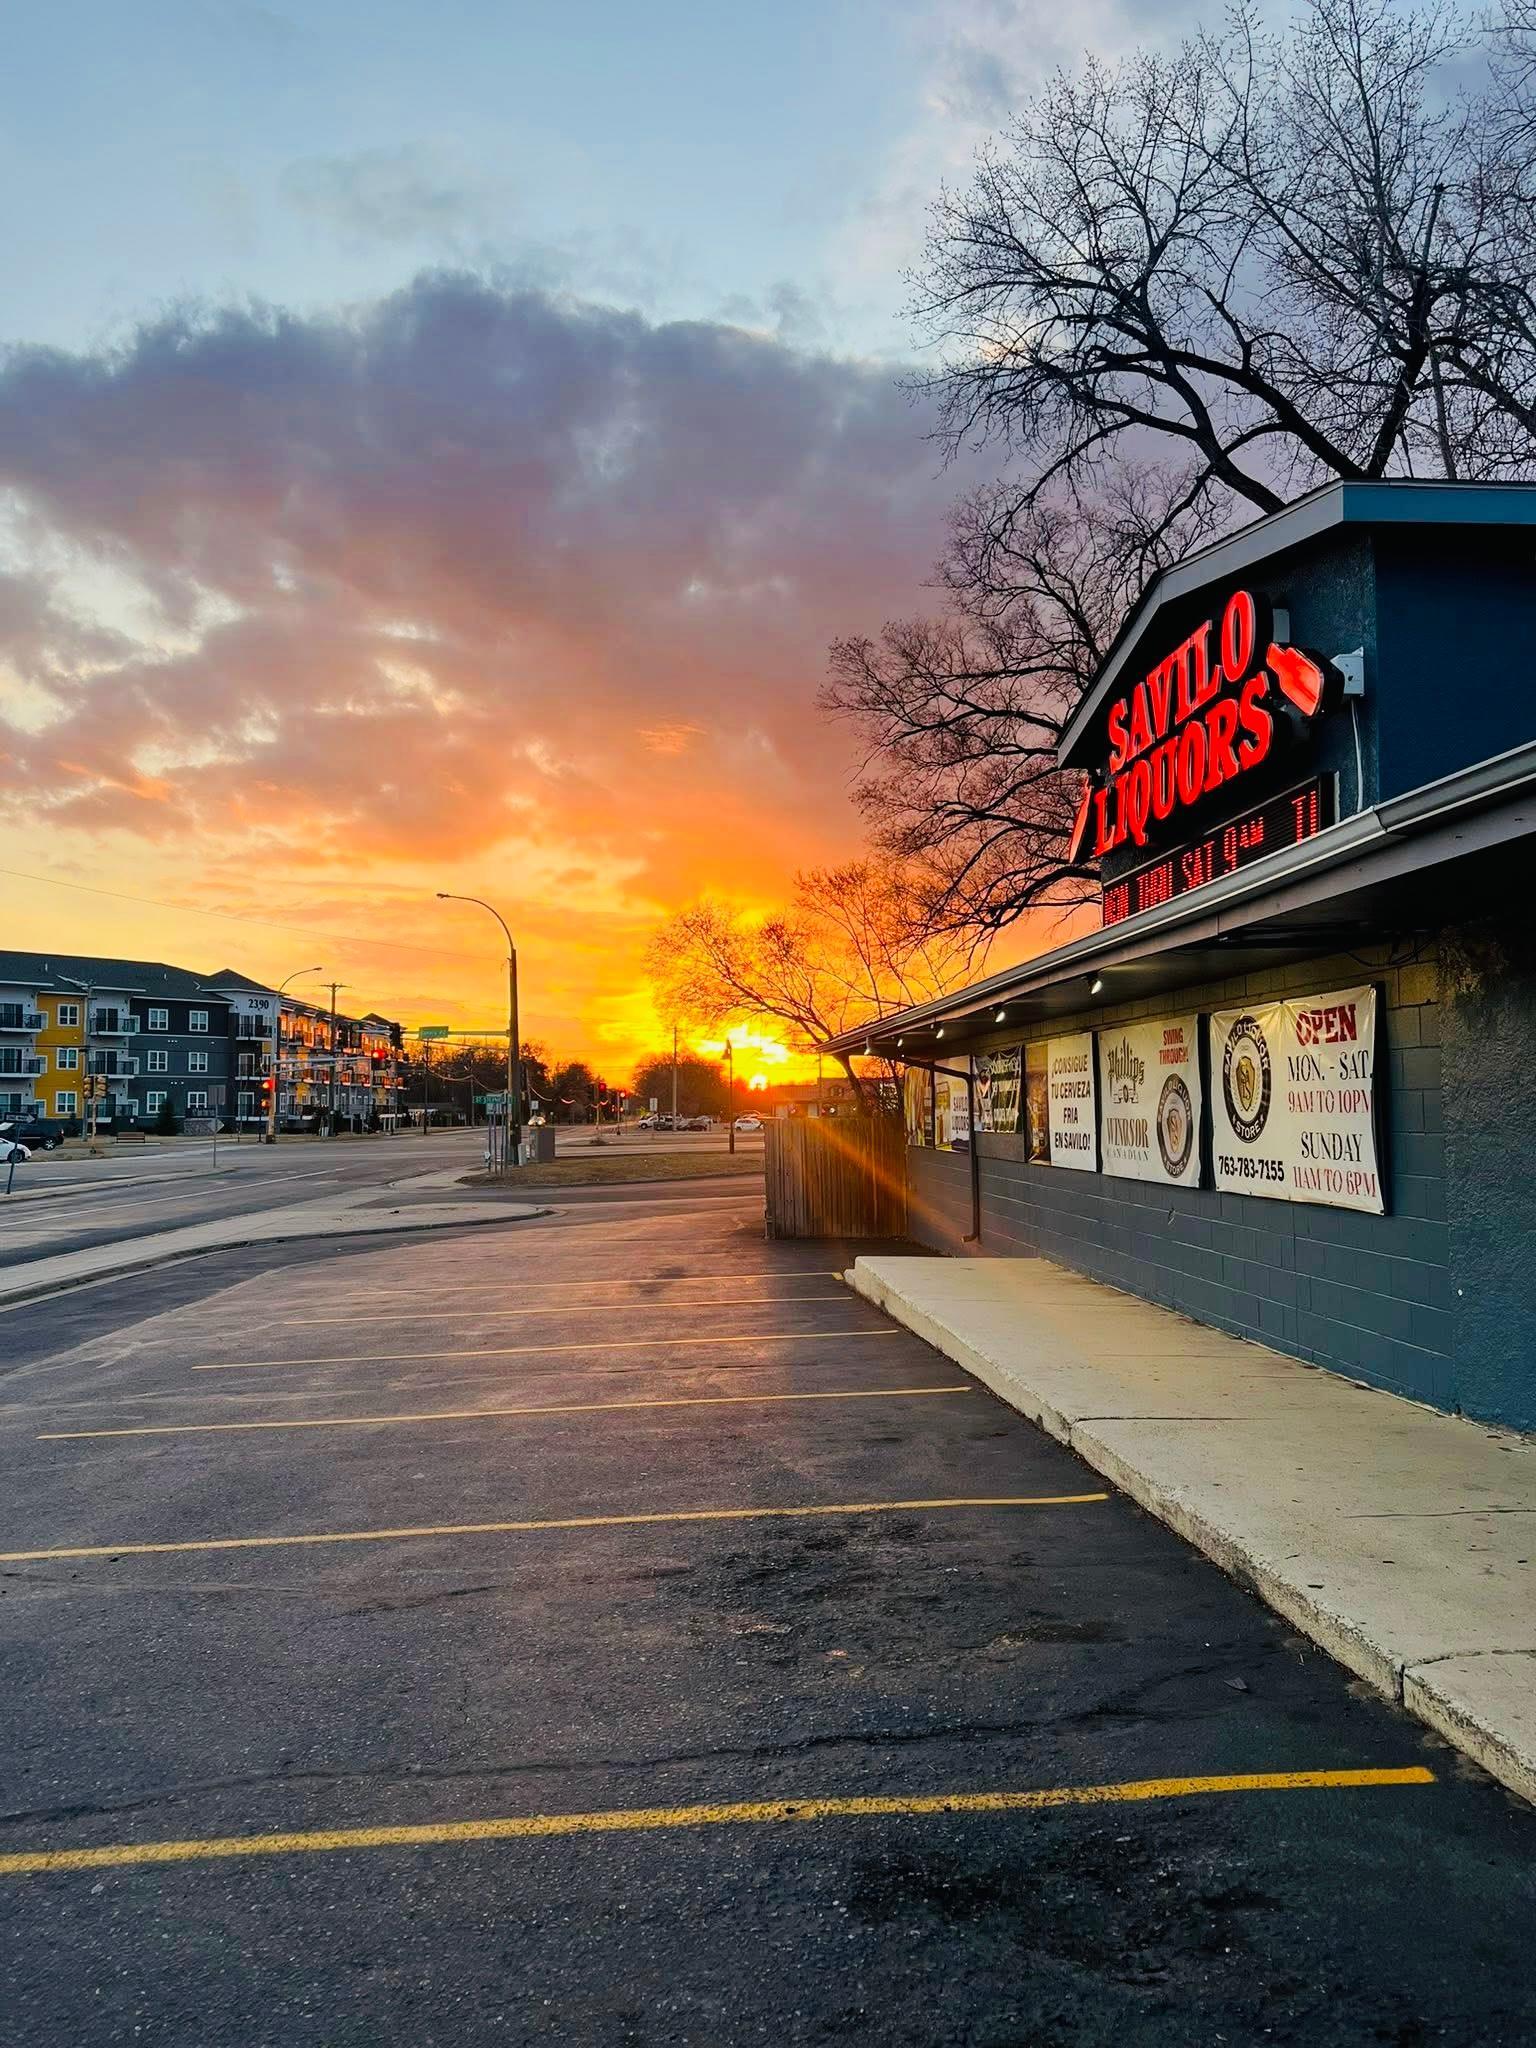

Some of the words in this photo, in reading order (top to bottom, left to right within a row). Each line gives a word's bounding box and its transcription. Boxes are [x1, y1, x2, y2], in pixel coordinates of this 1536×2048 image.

[1108, 589, 1256, 775] SAVILO
[1094, 670, 1273, 857] LIQUORS
[248, 998, 270, 1010] 2390
[1163, 1027, 1184, 1046] SWING
[1295, 1003, 1358, 1047] OPEN
[1051, 1054, 1088, 1079] ¡CONSIGUE
[1107, 1036, 1145, 1098] Phillips
[1159, 1047, 1189, 1066] THROUGH!
[1287, 1053, 1326, 1082] MON.
[1051, 1083, 1059, 1099] TU
[1060, 1080, 1091, 1100] CERVEZA
[1288, 1090, 1313, 1113] 9AM
[1316, 1089, 1335, 1114] TO
[1063, 1107, 1079, 1124] FRIA
[1055, 1132, 1063, 1149] EN
[1063, 1132, 1091, 1151] SAVILO!
[1106, 1117, 1150, 1149] WINDSOR
[1235, 1121, 1261, 1140] STORE
[1106, 1148, 1150, 1161] CANADIAN
[1300, 1131, 1364, 1163] SUNDAY
[1165, 1161, 1185, 1176] STORE
[1218, 1156, 1285, 1182] 763-783-7155
[1293, 1166, 1321, 1191] 11AM
[1323, 1168, 1343, 1193] TO
[1346, 1170, 1376, 1197] 6PM
